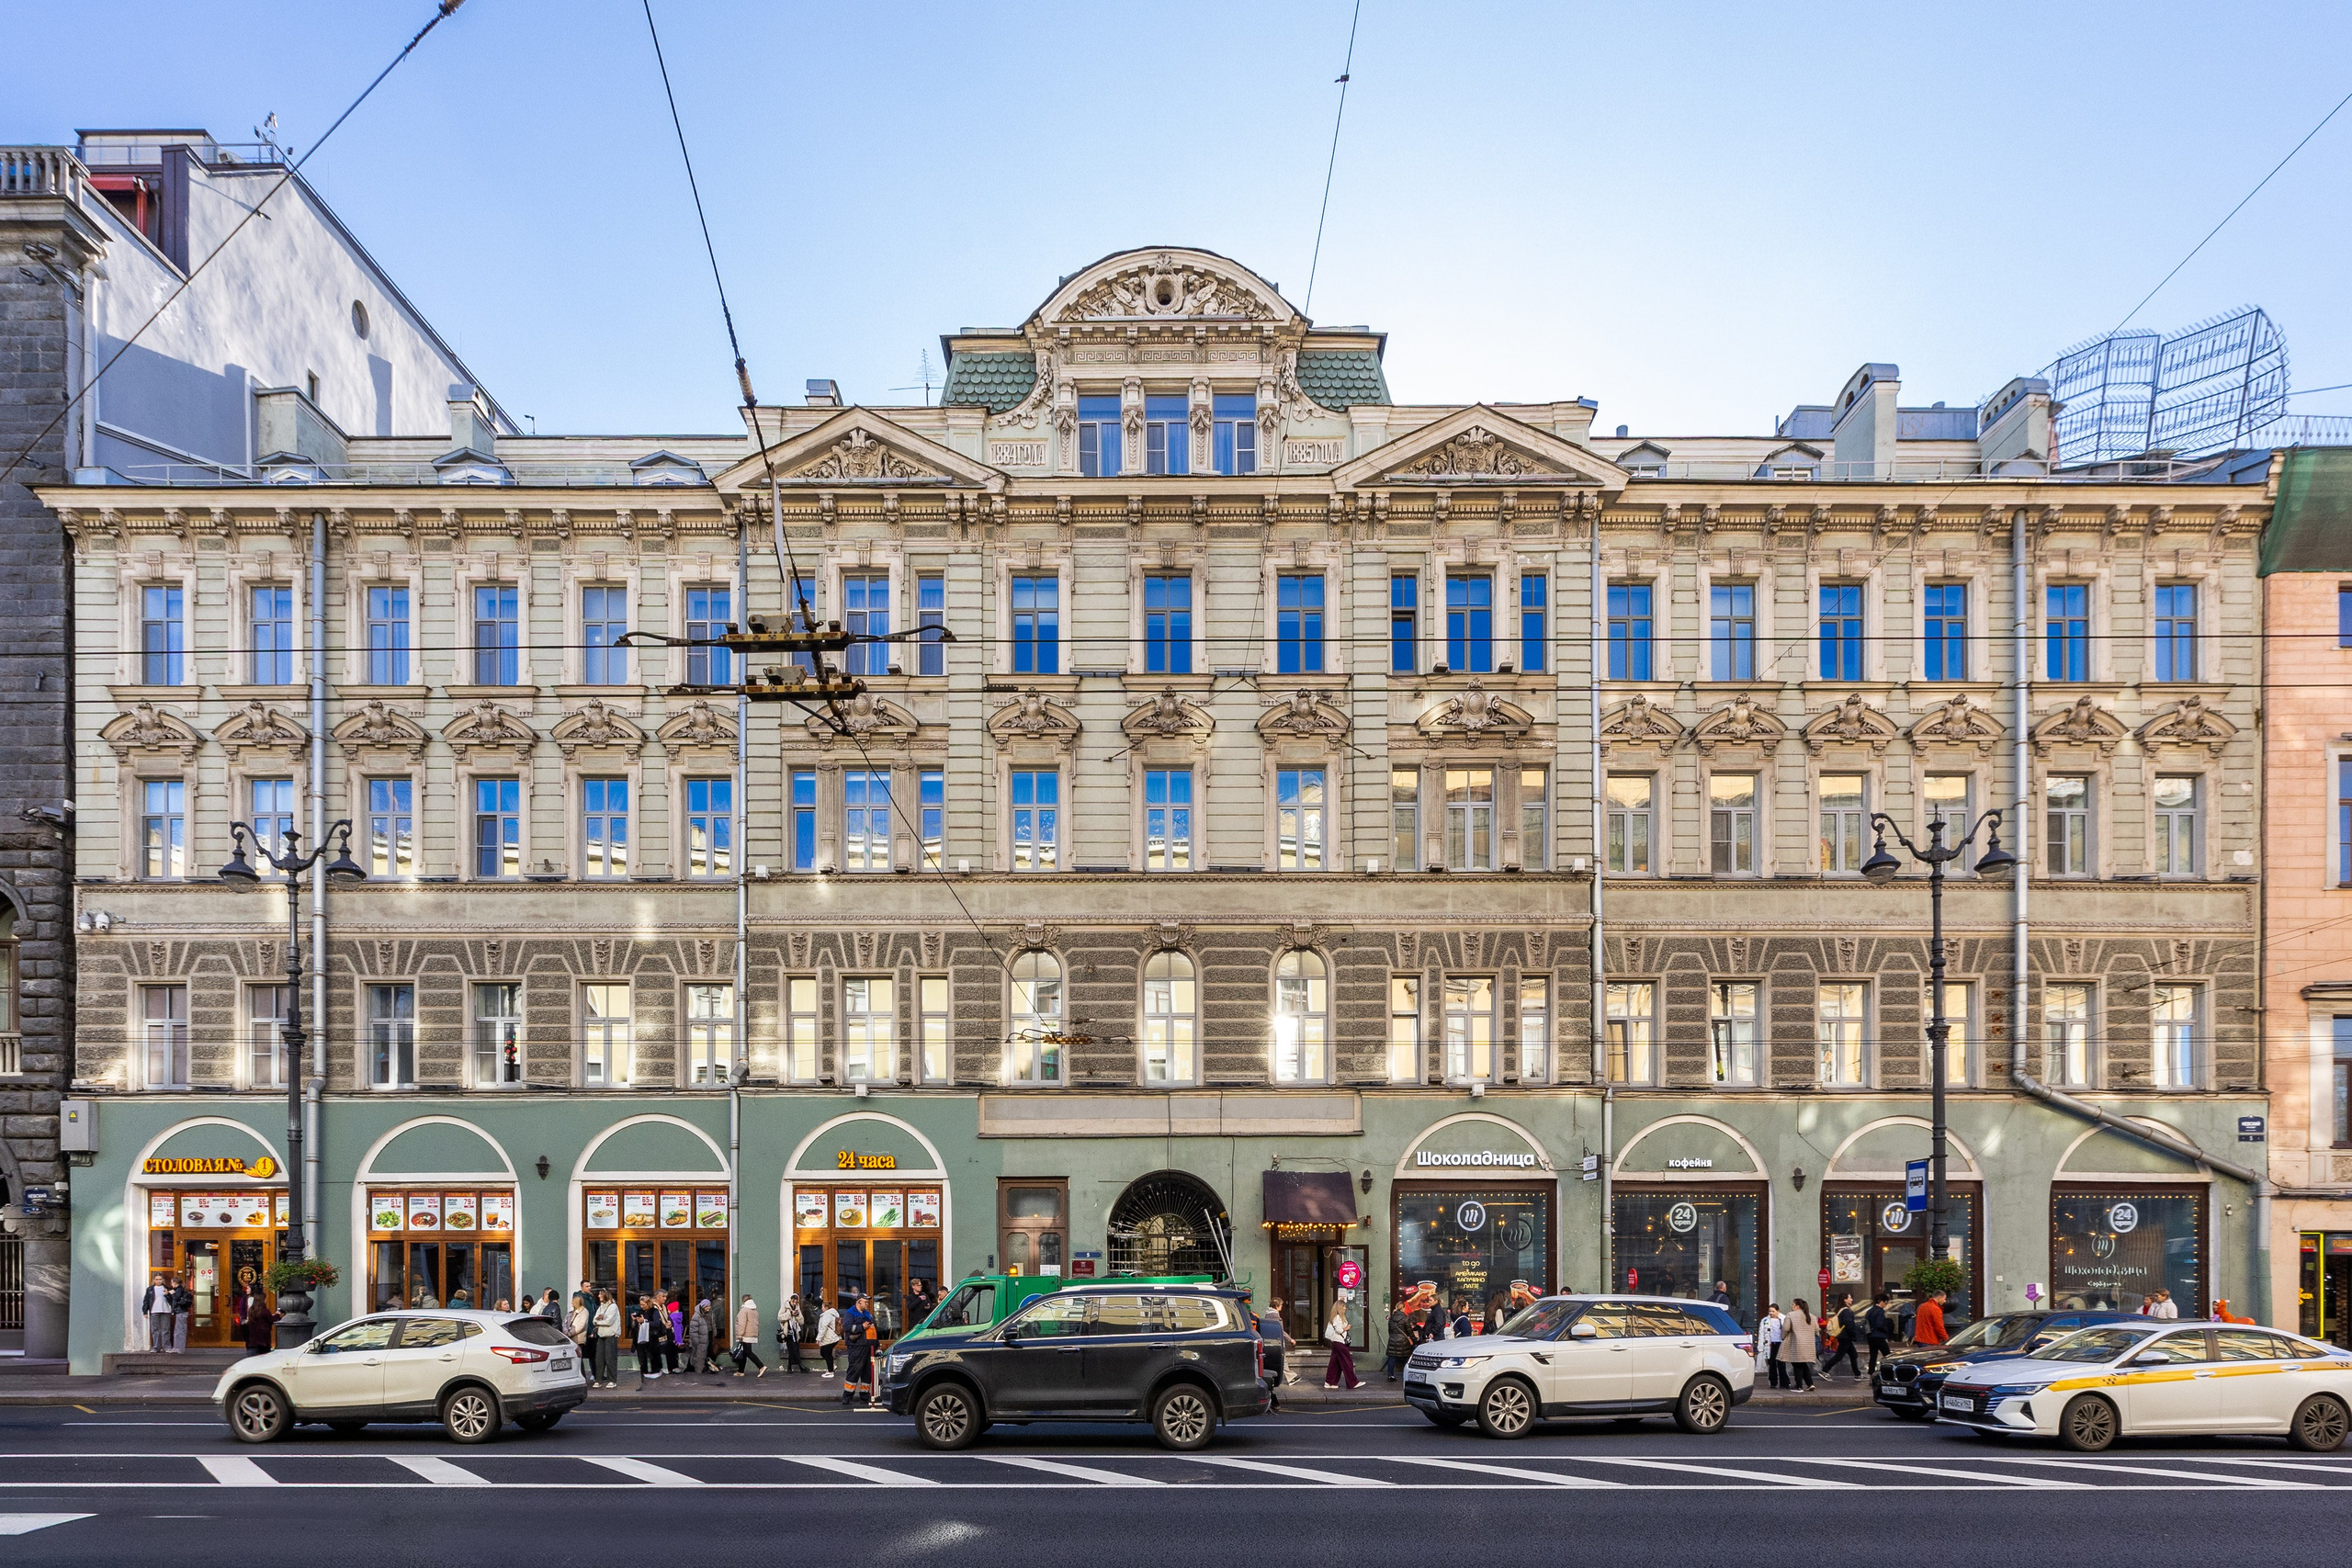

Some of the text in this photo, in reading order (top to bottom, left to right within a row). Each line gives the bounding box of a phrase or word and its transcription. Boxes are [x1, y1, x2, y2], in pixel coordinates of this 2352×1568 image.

[991, 445, 1016, 465] 1884
[1287, 442, 1314, 463] 1885
[838, 1150, 896, 1168] 24 часа
[1417, 1150, 1535, 1168] Шоколадница
[1668, 1157, 1713, 1168] кофейня
[1674, 1208, 1691, 1220] 24
[2115, 1208, 2132, 1220] 24
[1470, 1260, 1480, 1269] go
